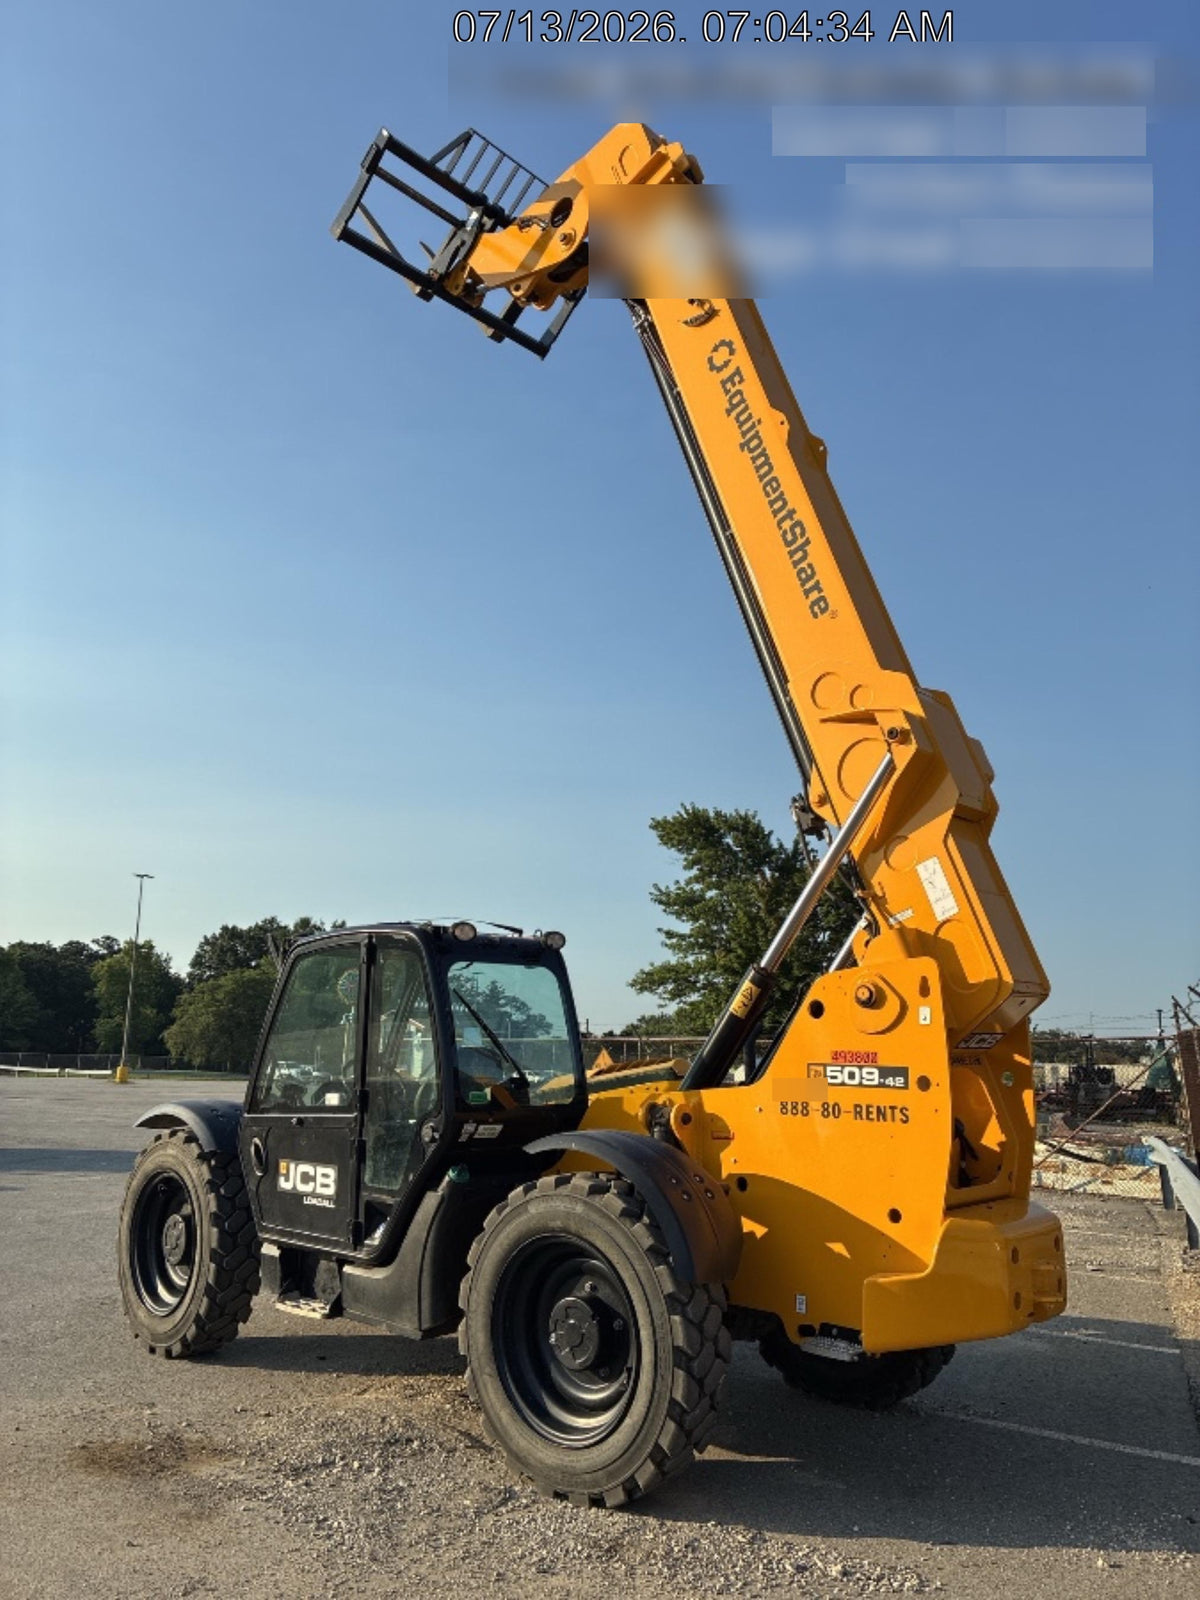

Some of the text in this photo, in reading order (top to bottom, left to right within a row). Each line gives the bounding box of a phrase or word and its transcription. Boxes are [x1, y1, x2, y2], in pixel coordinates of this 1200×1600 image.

[720, 366, 830, 619] EquipmentShare
[958, 1034, 1004, 1048] JCB
[279, 1162, 336, 1195] JCB
